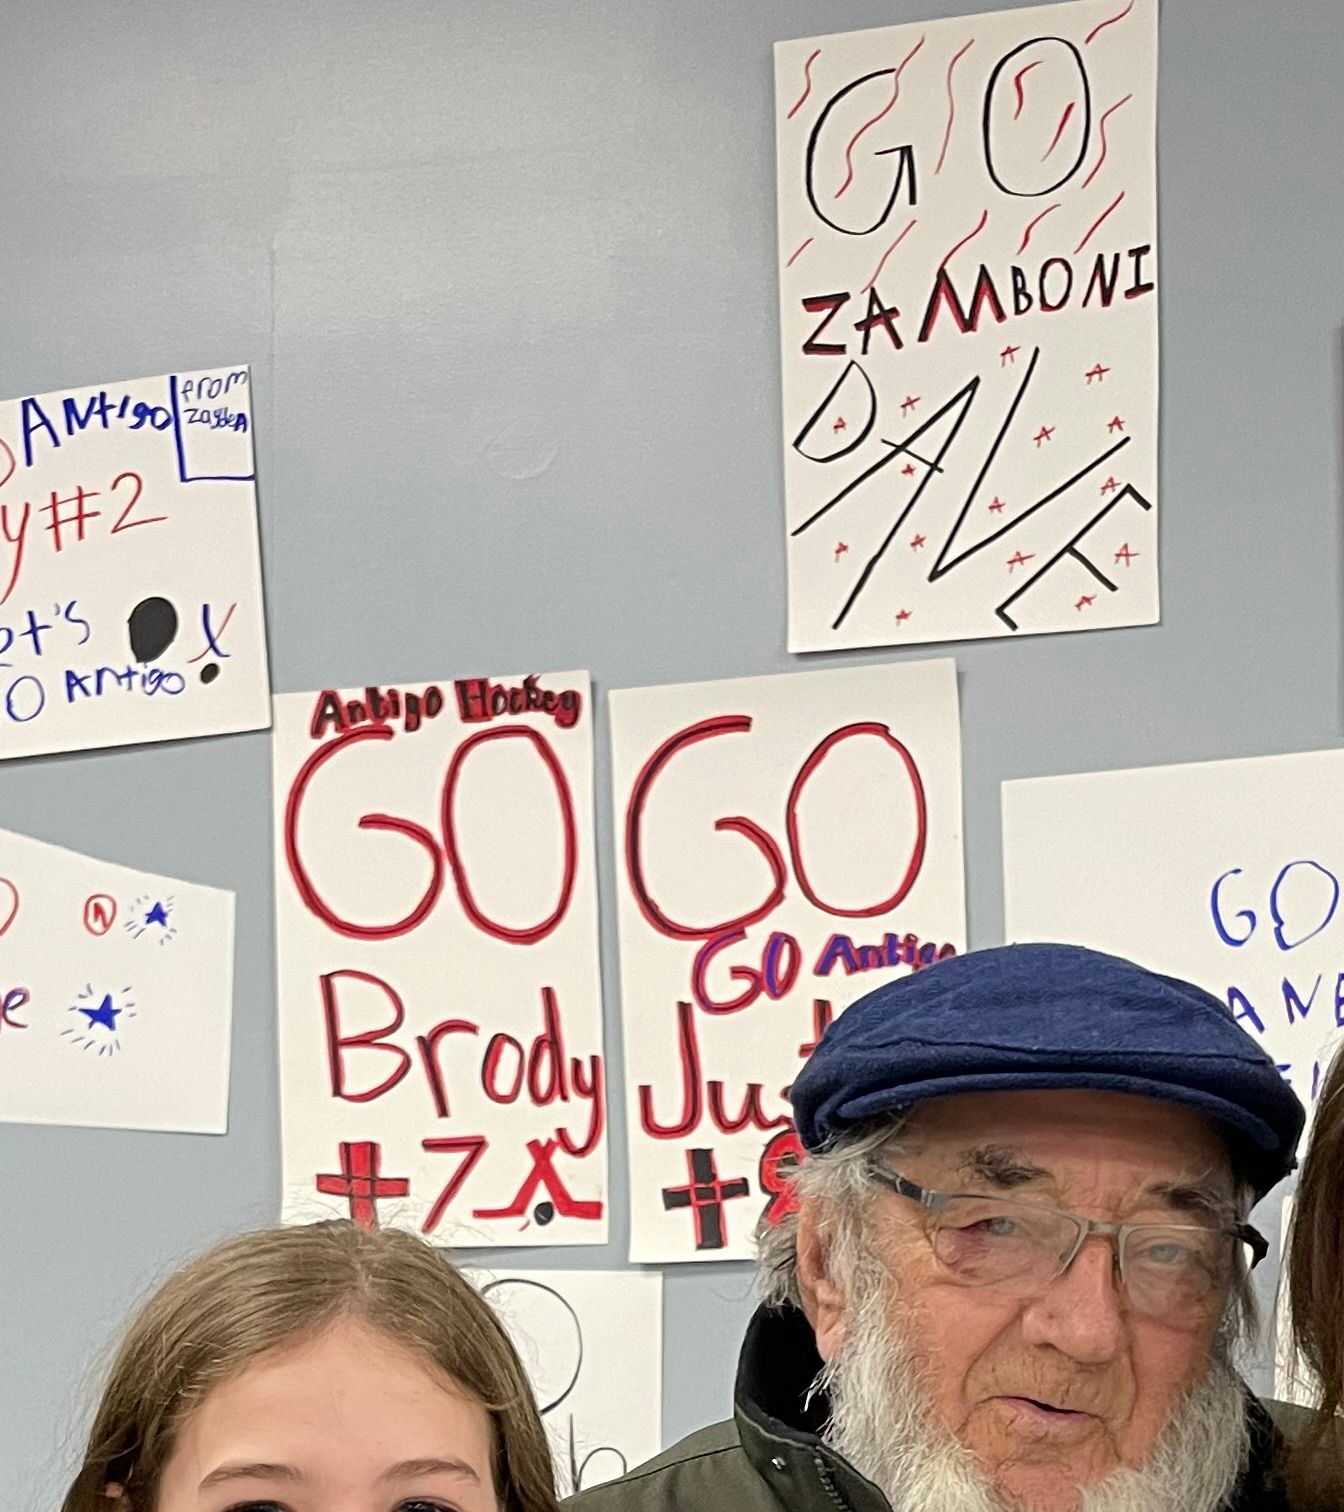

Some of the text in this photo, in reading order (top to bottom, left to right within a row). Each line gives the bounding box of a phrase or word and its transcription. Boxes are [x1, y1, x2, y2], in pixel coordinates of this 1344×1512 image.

[806, 36, 1091, 236] GO
[801, 244, 1154, 356] ZAMBONI
[791, 347, 1152, 630] DAVE
[284, 725, 578, 946] GO
[625, 714, 928, 942] GO
[1210, 860, 1341, 952] GO
[320, 968, 603, 1159] Brody
